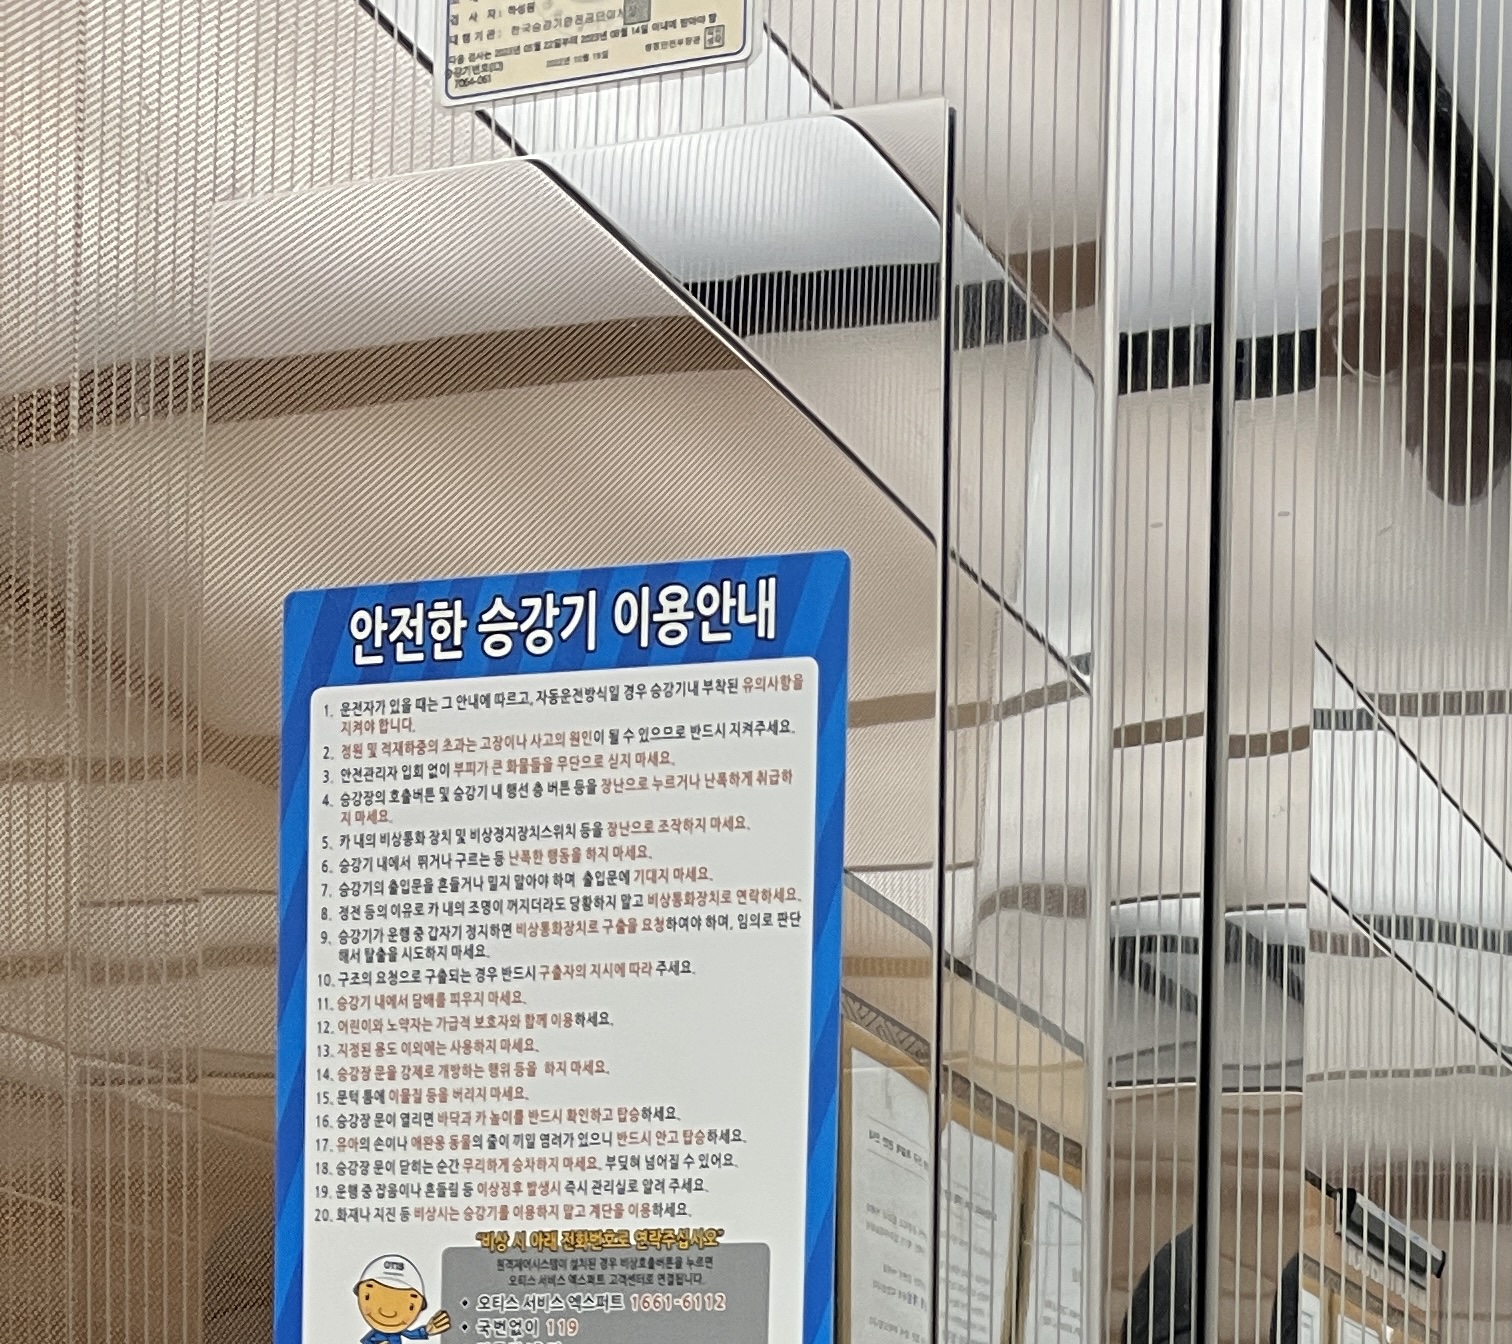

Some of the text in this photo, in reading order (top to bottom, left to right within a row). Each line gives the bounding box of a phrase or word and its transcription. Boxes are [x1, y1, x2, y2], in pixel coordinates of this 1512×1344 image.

[350, 576, 777, 666] 안전한 승강기 이용안내
[323, 702, 335, 719] 1.
[338, 697, 387, 719] 운전자가
[388, 696, 413, 716] 있을
[414, 695, 440, 714] 때는
[439, 694, 454, 710] 그
[454, 691, 492, 712] 안내에
[534, 683, 621, 707] 자동운전방식일
[622, 681, 648, 702] 경우
[648, 678, 700, 700] 승강기내
[700, 675, 739, 697] 부착된
[740, 672, 805, 695] 유의사항을
[339, 715, 417, 737] 지켜야 합니다.
[316, 988, 528, 1013] 11. 승강기 내에서 담배를 피우지 마세요.
[316, 1036, 540, 1059] 13. 지정된 용도 이외에는 사용하지 마세요.
[512, 1229, 529, 1252] 시
[529, 1229, 559, 1252] 아래
[560, 1227, 632, 1252] 전화번호로
[569, 1256, 598, 1272] 설치된
[599, 1255, 618, 1271] 경우
[685, 1254, 714, 1271] 누르면
[507, 1273, 537, 1288] 오티스
[537, 1273, 567, 1288] 서비스
[567, 1272, 607, 1288] 엑스퍼트
[608, 1272, 655, 1287] 고객센터로
[475, 1291, 728, 1313] 오티스 서비스 엑스퍼트 1661-6112
[474, 1317, 580, 1340] 국번없이 119
